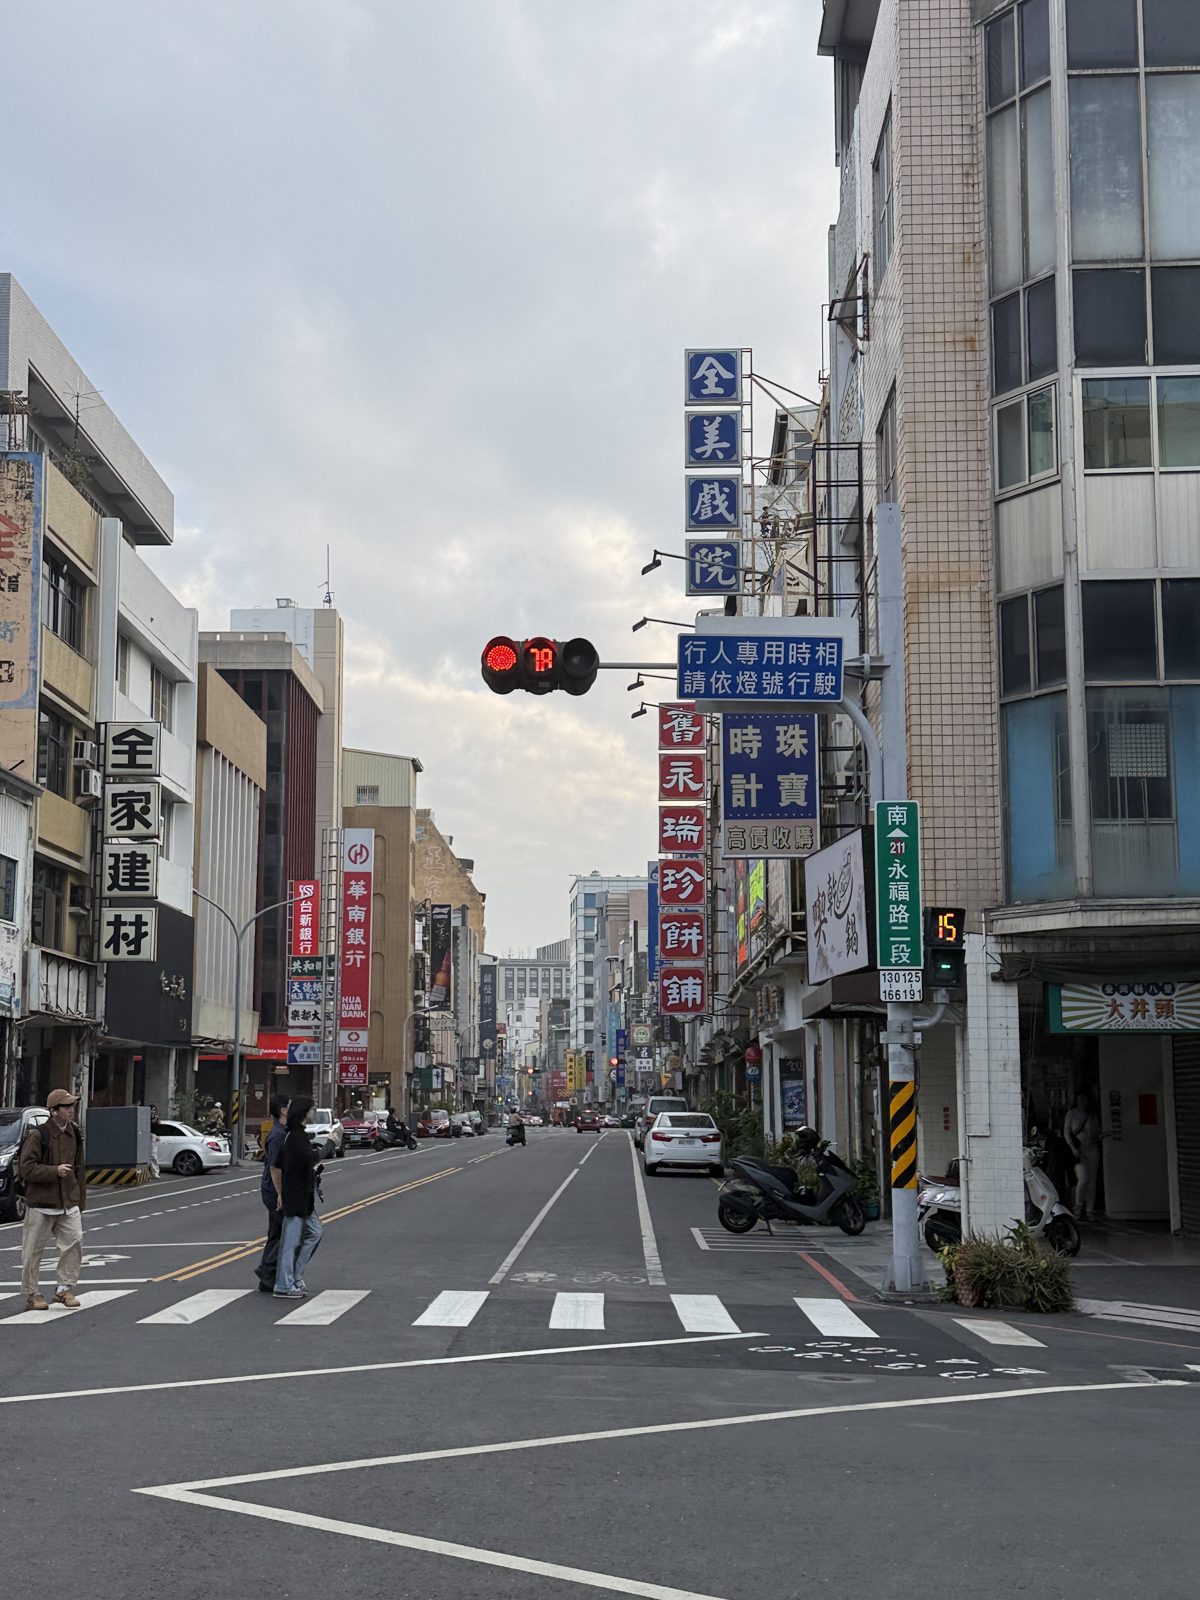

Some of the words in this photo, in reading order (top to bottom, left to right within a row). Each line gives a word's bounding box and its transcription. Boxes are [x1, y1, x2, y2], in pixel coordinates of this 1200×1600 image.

[692, 356, 737, 587] 全美戲院
[684, 640, 838, 667] 行人專用時相
[684, 670, 837, 697] 請依燈號行駛
[729, 724, 763, 808] 時計
[776, 724, 809, 808] 珠寶
[886, 805, 908, 827] 南
[104, 727, 155, 957] 全家建材
[727, 825, 814, 851] 高價收購
[890, 841, 906, 854] 211
[345, 879, 368, 968] 華南銀行
[888, 859, 912, 964] 永福路二段
[299, 900, 313, 954] 台新銀行
[937, 912, 957, 942] 15
[882, 972, 901, 984] 130
[902, 972, 921, 984] 125
[341, 1003, 362, 1011] NAN
[882, 989, 901, 1001] 166
[903, 989, 921, 1001] 191
[1105, 997, 1176, 1020] 大井頭
[341, 1010, 367, 1018] BANK
